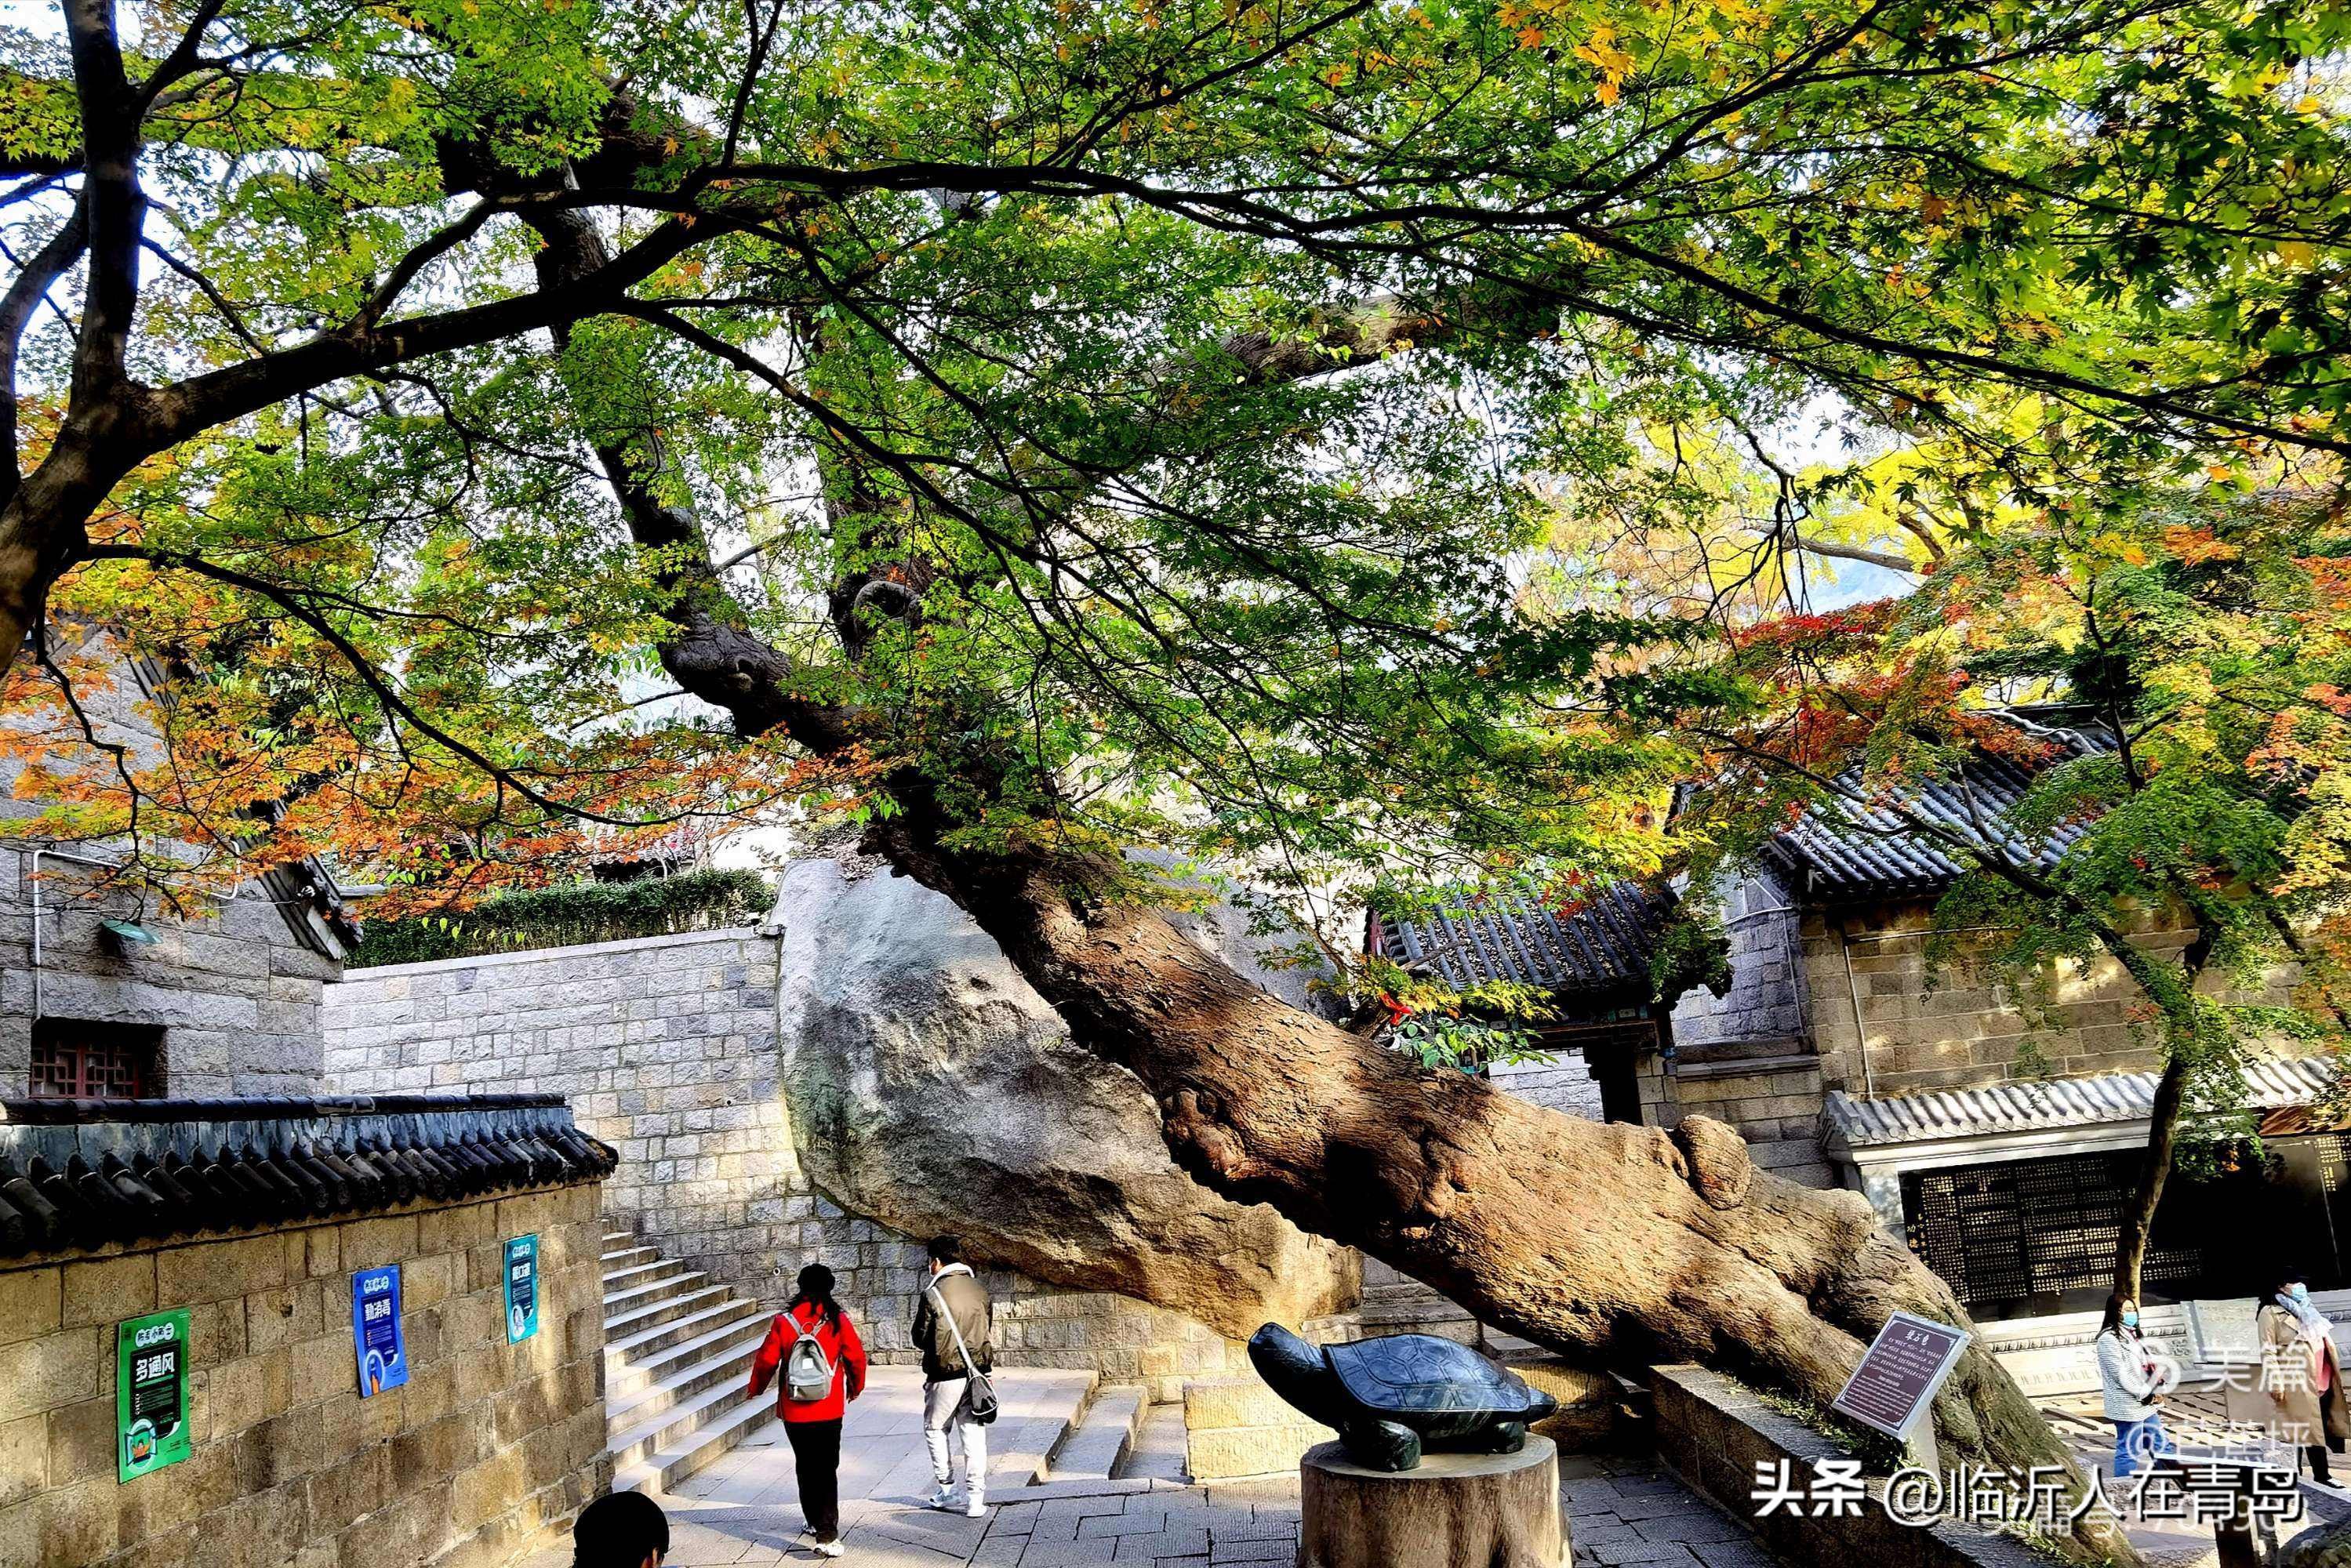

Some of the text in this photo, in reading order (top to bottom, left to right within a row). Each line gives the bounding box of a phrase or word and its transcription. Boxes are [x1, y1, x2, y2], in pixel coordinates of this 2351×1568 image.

[365, 1298, 391, 1321] 勤消毒
[136, 1352, 175, 1382] 多通风
